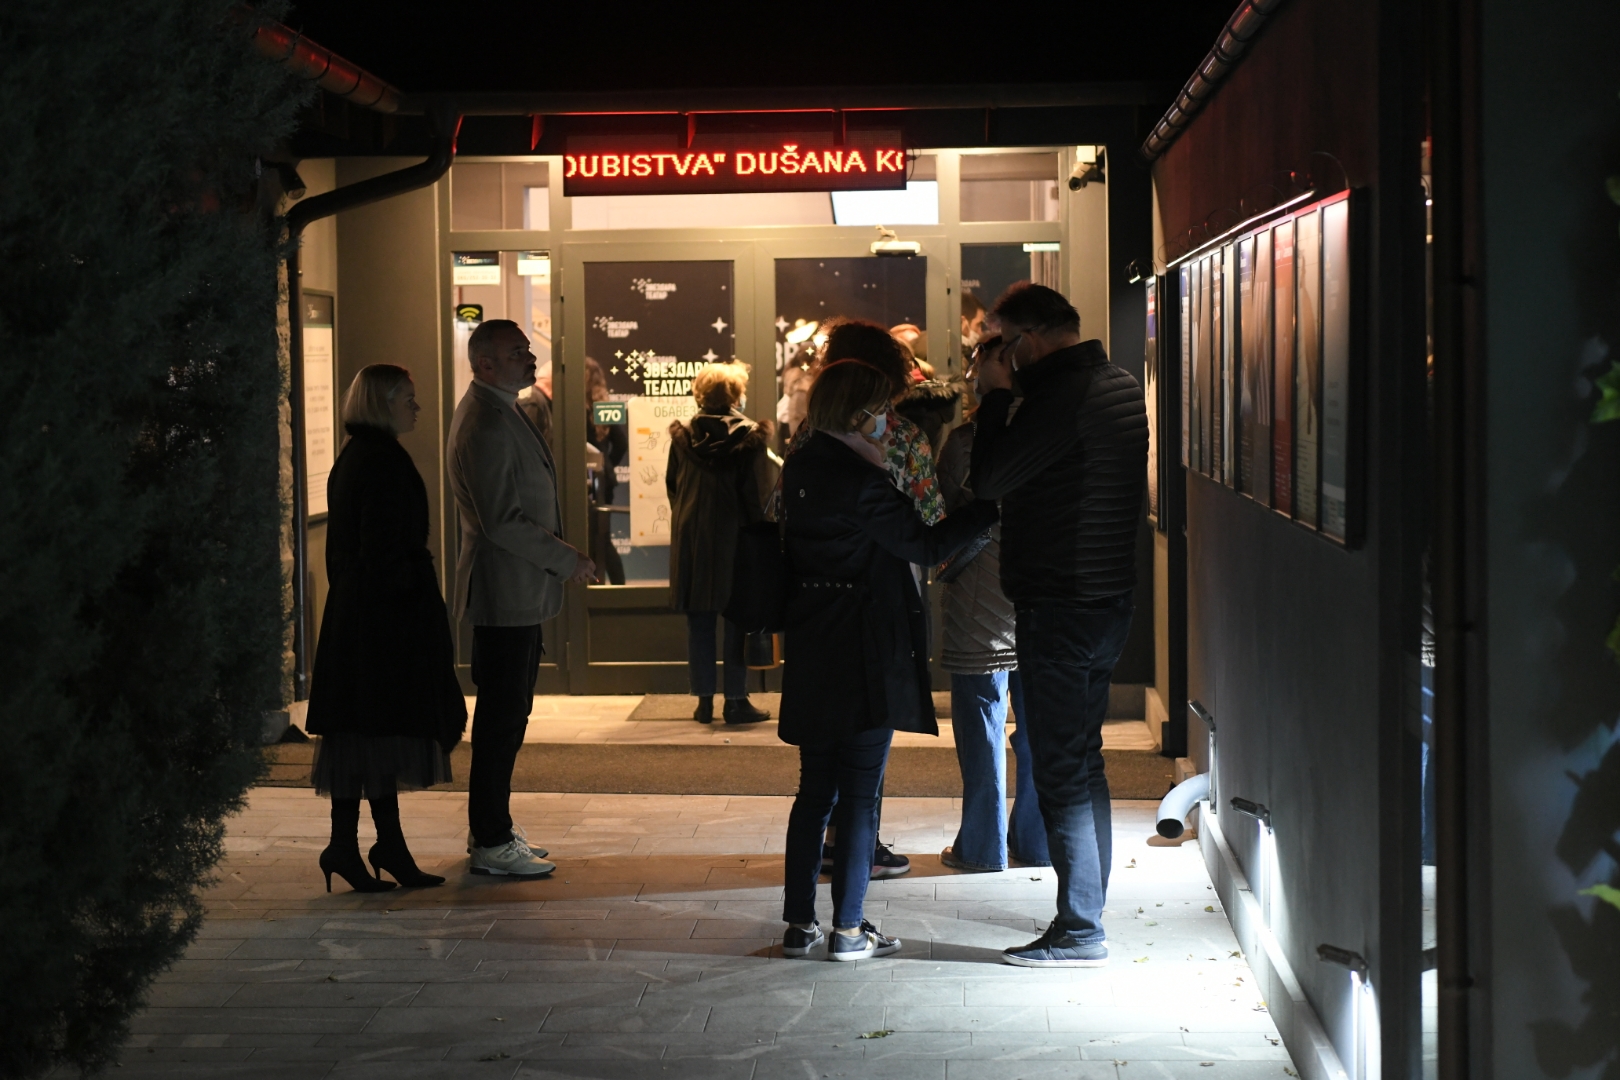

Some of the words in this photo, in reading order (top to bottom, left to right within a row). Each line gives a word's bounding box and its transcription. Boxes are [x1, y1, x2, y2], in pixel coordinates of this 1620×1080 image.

[736, 145, 867, 175] DUŠANA
[643, 379, 692, 396] ТЕАТАР
[597, 409, 622, 423] 170
